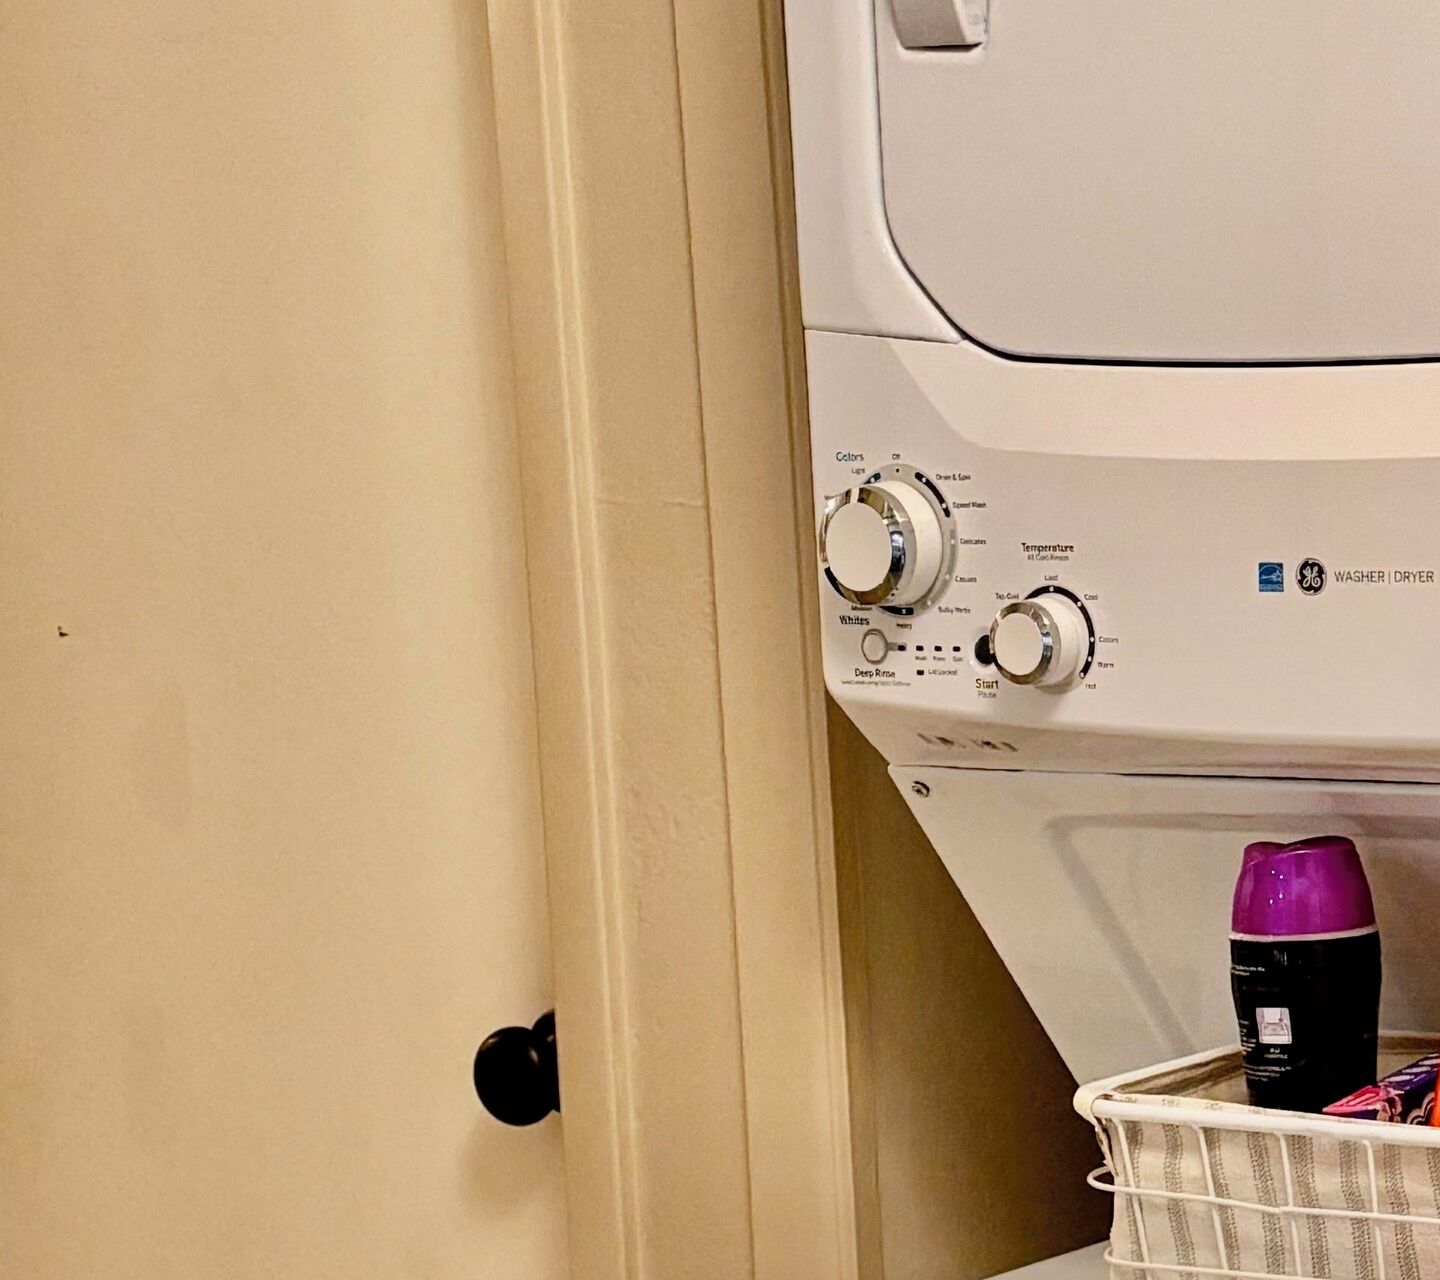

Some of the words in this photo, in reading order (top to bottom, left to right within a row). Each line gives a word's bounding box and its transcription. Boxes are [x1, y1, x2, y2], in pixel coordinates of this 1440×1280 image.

[836, 451, 865, 462] Colors
[1021, 542, 1074, 555] Temperature
[1334, 570, 1385, 583] WASHER
[1394, 570, 1435, 583] DRYER
[839, 615, 870, 626] Whites
[855, 669, 874, 678] Deep
[875, 669, 896, 678] Rinse
[975, 678, 999, 690] Start
